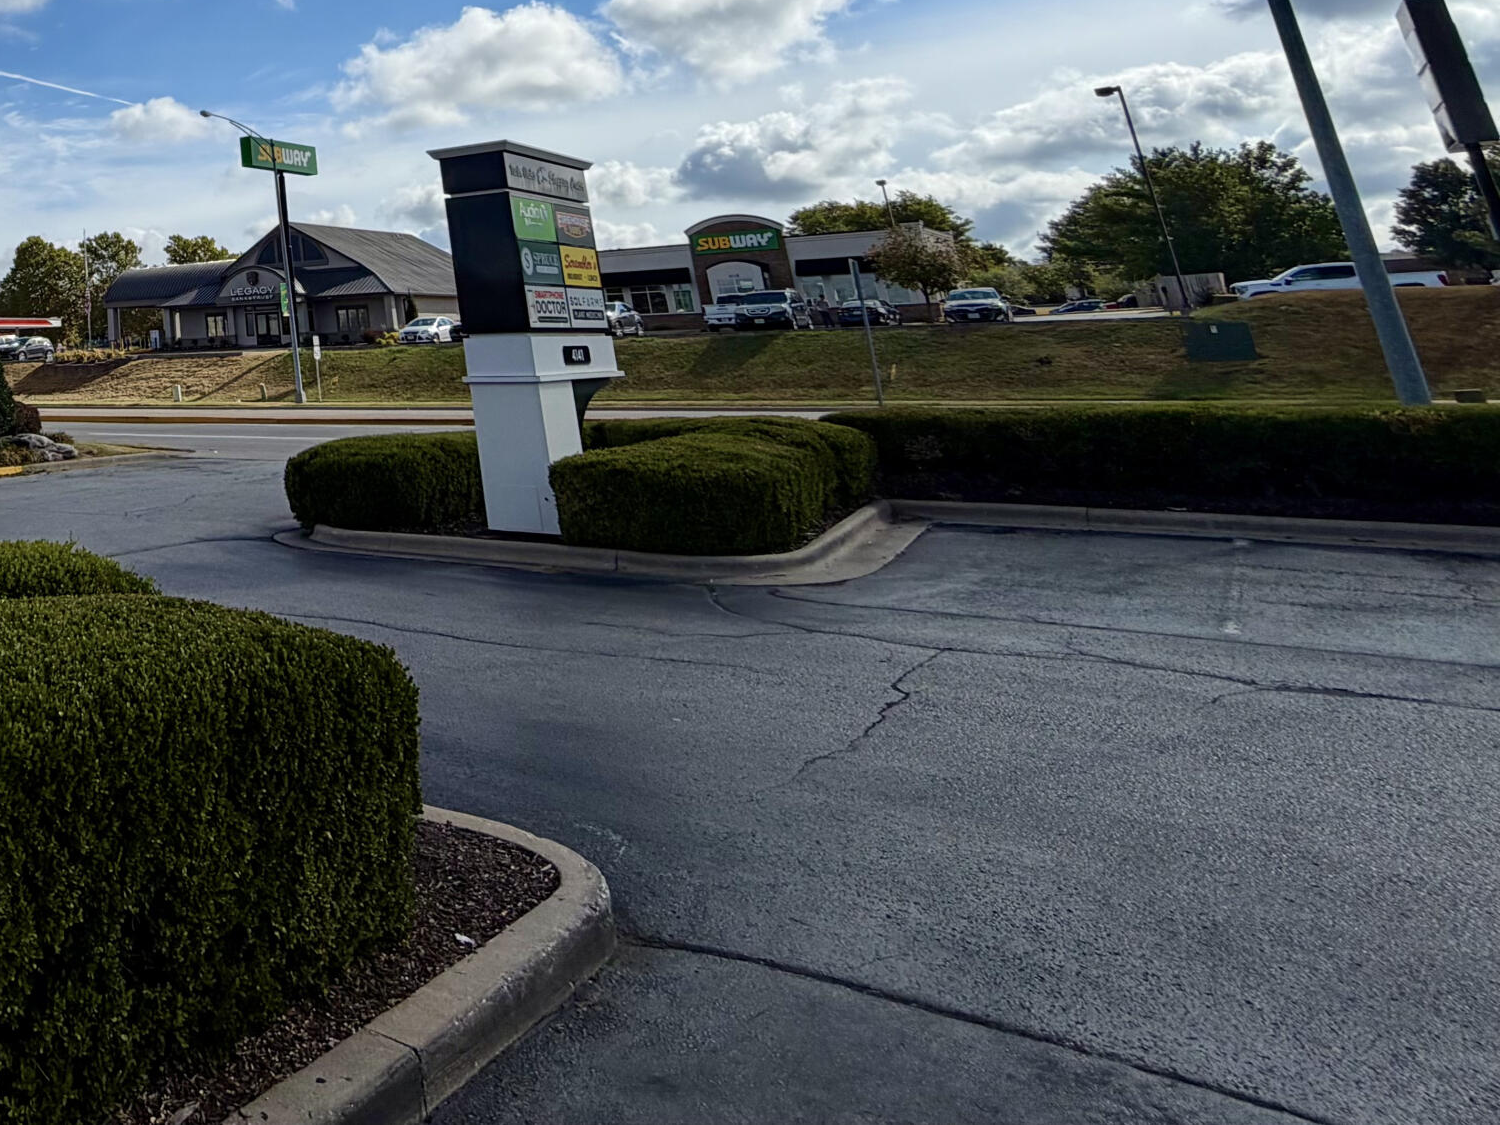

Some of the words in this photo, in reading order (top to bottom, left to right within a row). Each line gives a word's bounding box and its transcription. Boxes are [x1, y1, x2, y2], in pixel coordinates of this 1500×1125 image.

[696, 232, 773, 251] SUBWAY
[230, 285, 275, 296] LEGACY
[535, 300, 567, 314] DOCTOR
